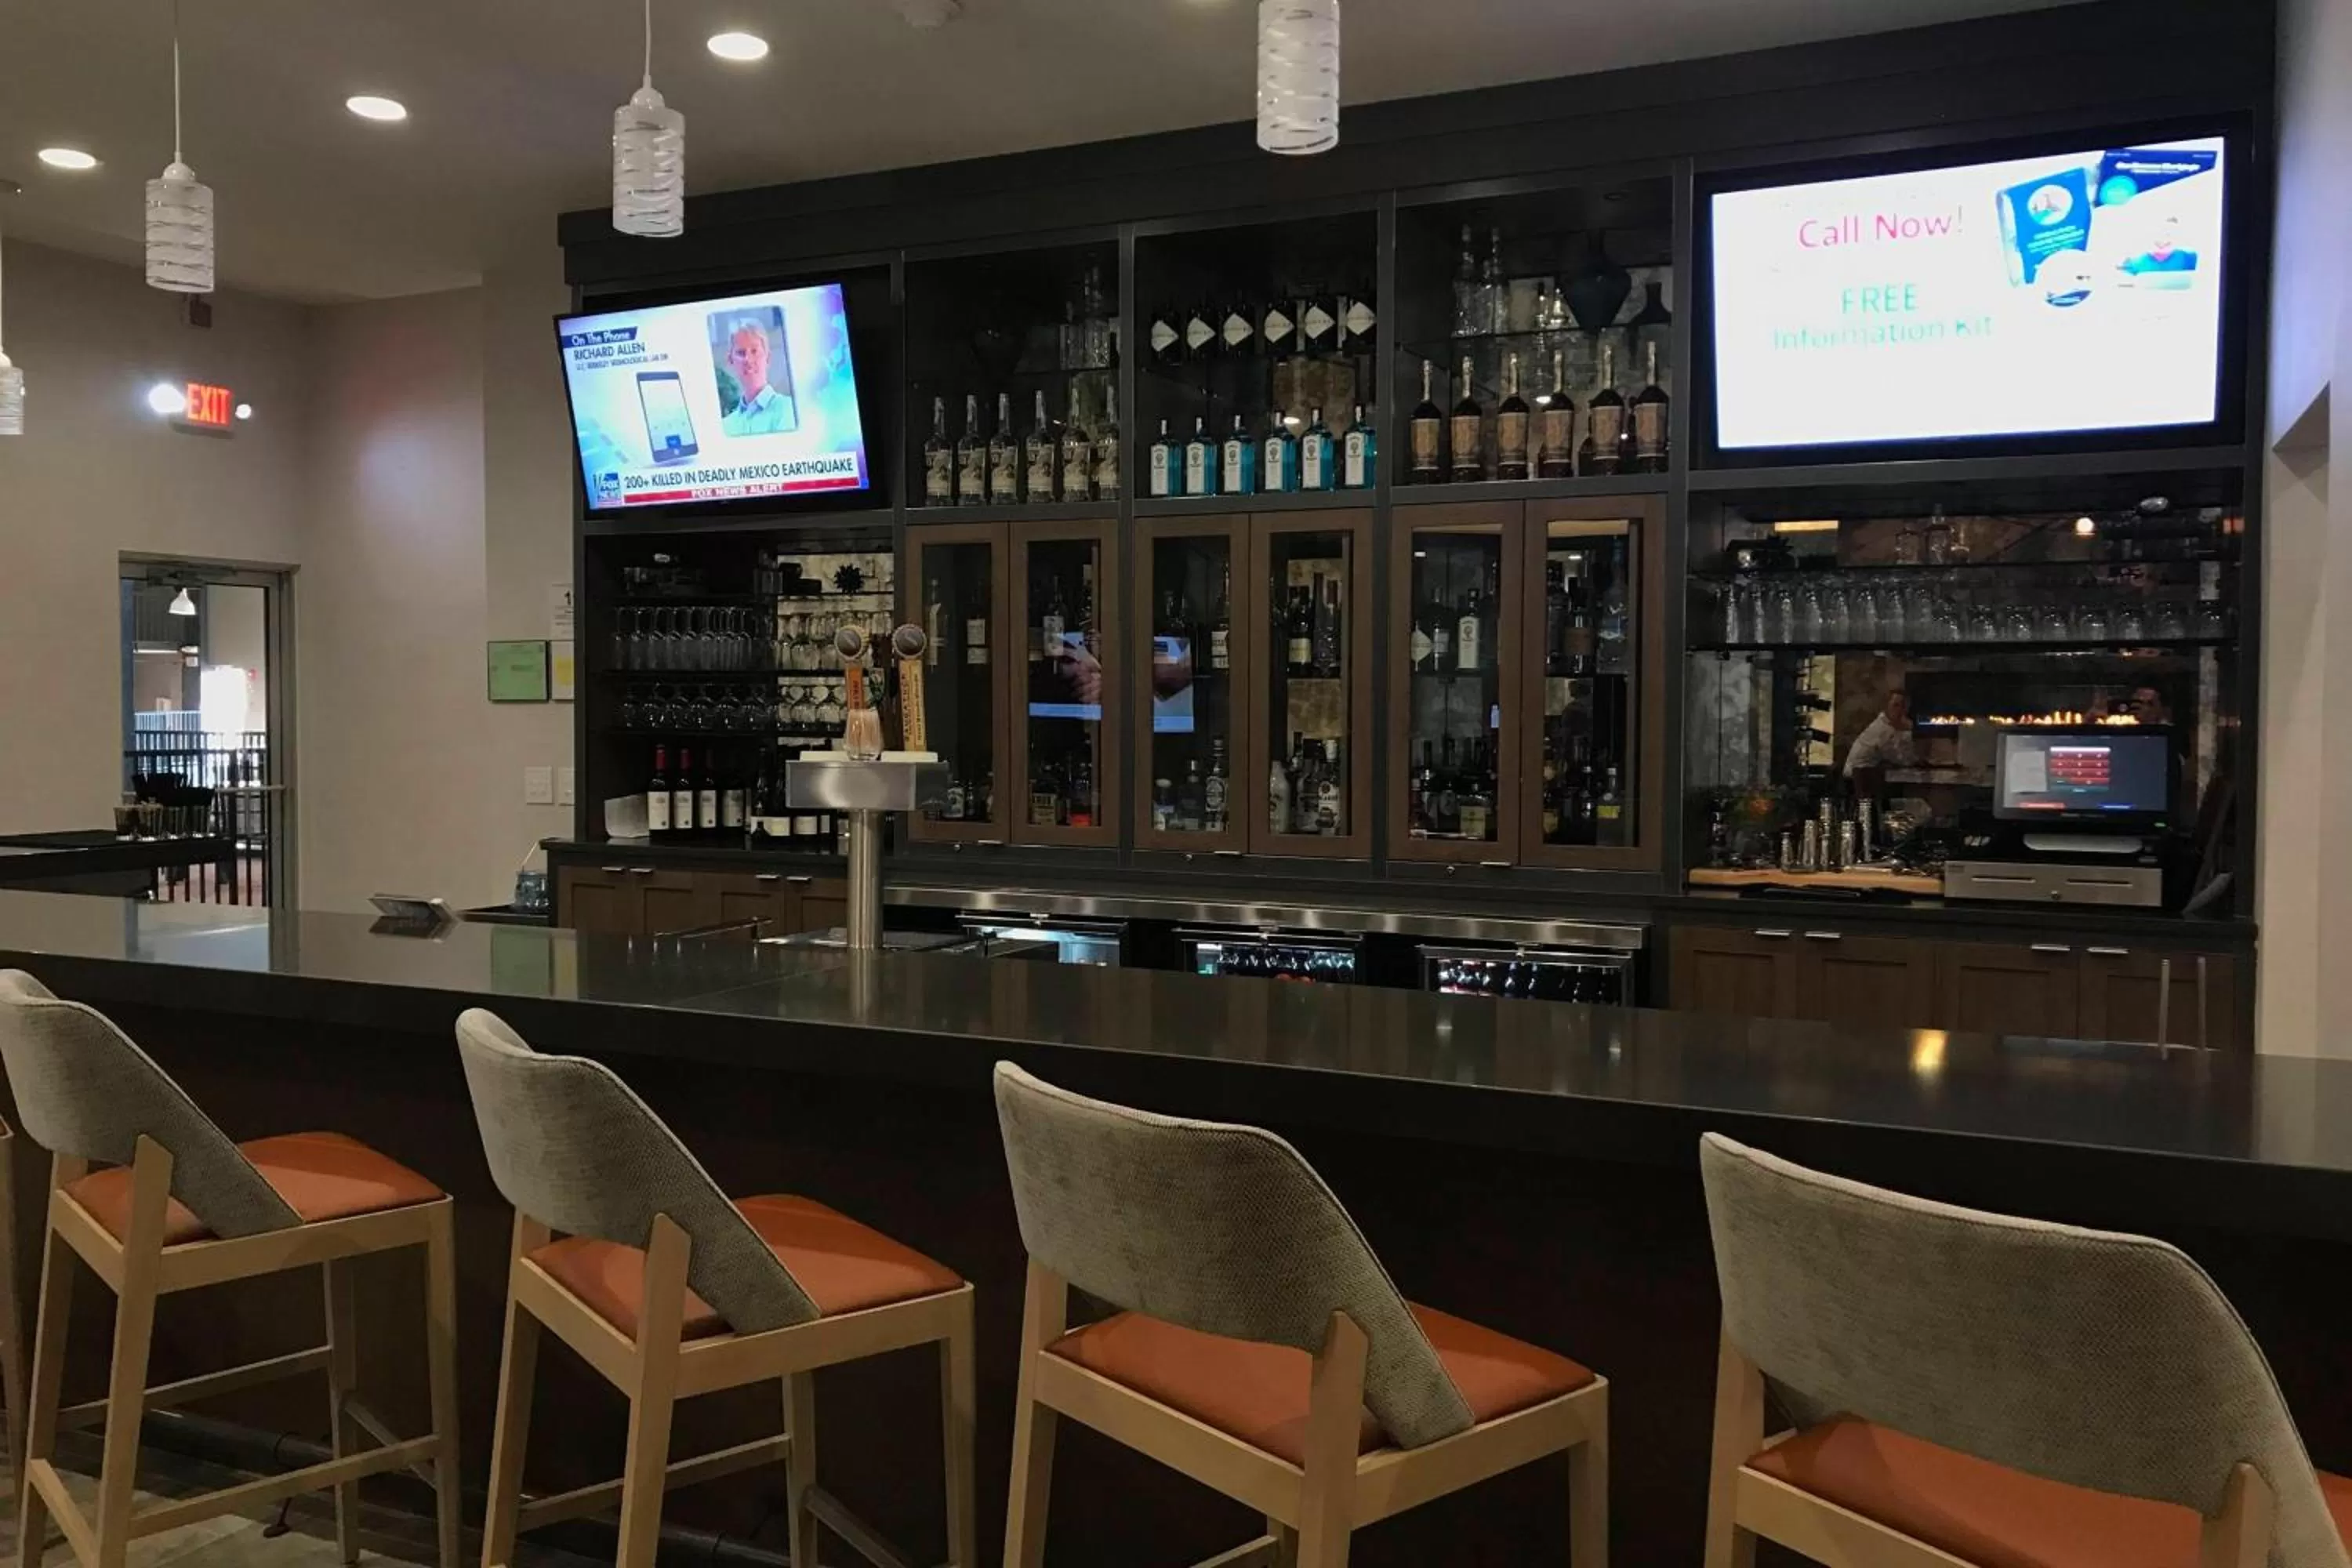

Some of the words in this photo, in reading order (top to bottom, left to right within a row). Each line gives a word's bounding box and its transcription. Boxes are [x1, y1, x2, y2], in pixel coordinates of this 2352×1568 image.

[1799, 215, 1859, 248] Call
[1875, 204, 1963, 240] Now!
[1842, 283, 1919, 314] FREE
[572, 334, 586, 347] On
[587, 332, 601, 345] The
[603, 329, 630, 343] Phone
[1773, 321, 1945, 350] Information
[1955, 316, 1992, 339] Kit
[573, 345, 615, 361] RICHARD
[617, 342, 646, 355] ALLEN
[187, 383, 230, 425] EXIT
[624, 475, 649, 488] 200+
[652, 472, 683, 487] KILLED
[685, 472, 697, 485] IN
[699, 467, 739, 483] DEADLY
[740, 463, 780, 480] MEXICO
[782, 457, 854, 476] EARTHQUAKE
[691, 488, 710, 499] FOX
[715, 485, 746, 497] NEWS
[750, 482, 782, 495] ALERT
